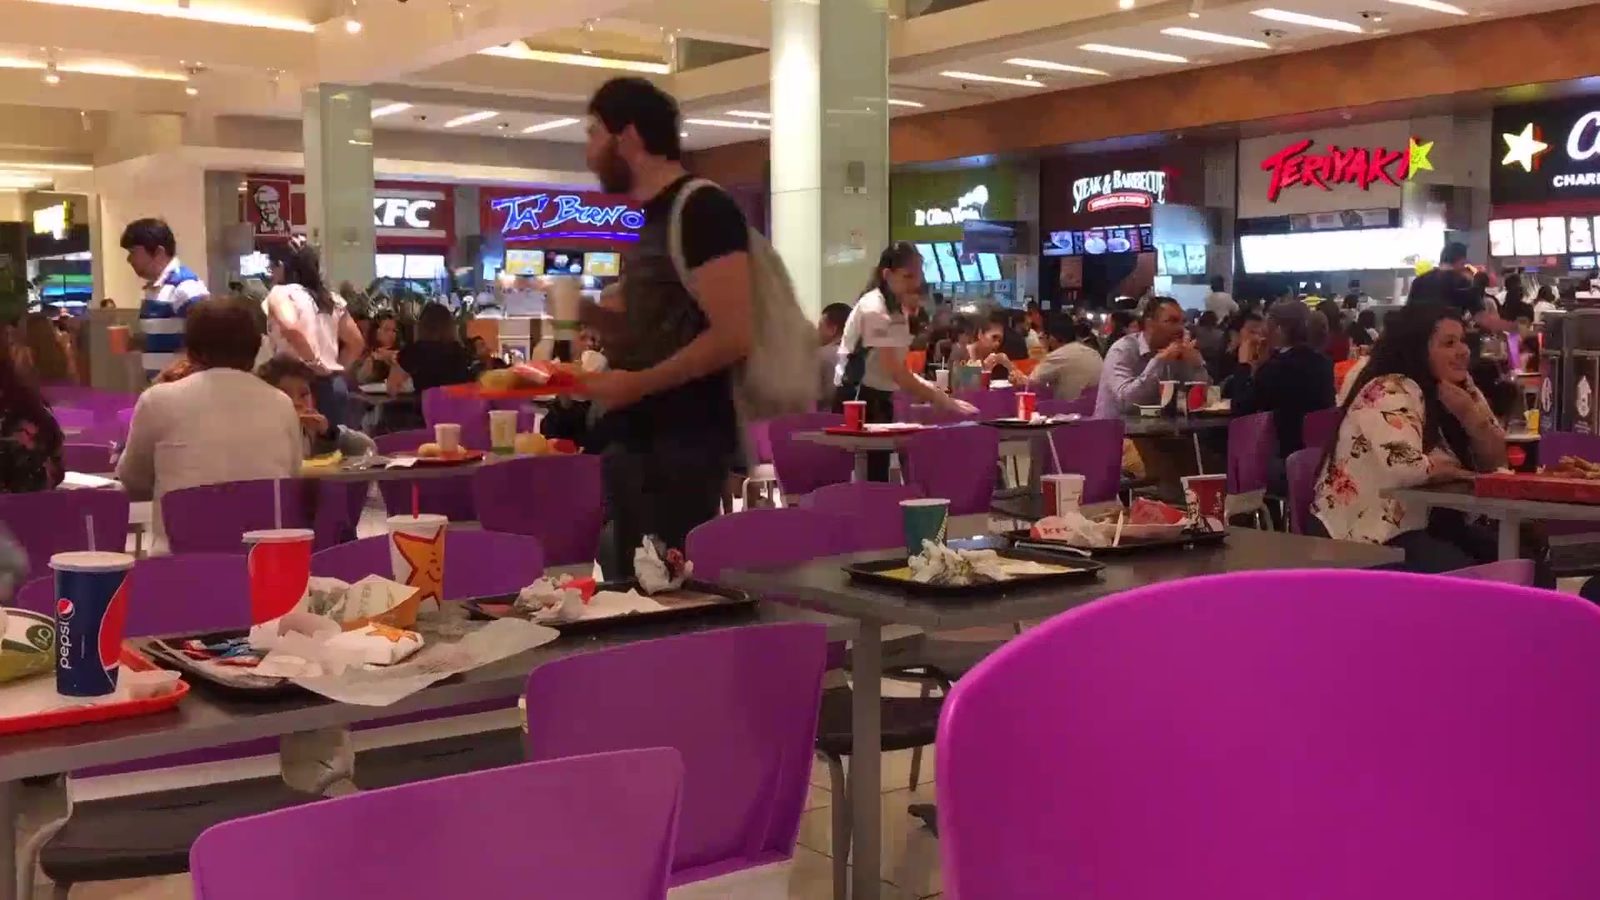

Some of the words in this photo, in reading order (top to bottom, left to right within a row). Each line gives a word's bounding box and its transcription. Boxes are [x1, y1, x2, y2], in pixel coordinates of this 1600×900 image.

[1072, 177, 1103, 213] STEAK
[1102, 174, 1112, 194] &
[1113, 170, 1165, 204] BARBECUE
[1260, 139, 1411, 202] TERIYAKI
[1553, 172, 1600, 187] CHAR
[60, 618, 72, 669] pepsi
